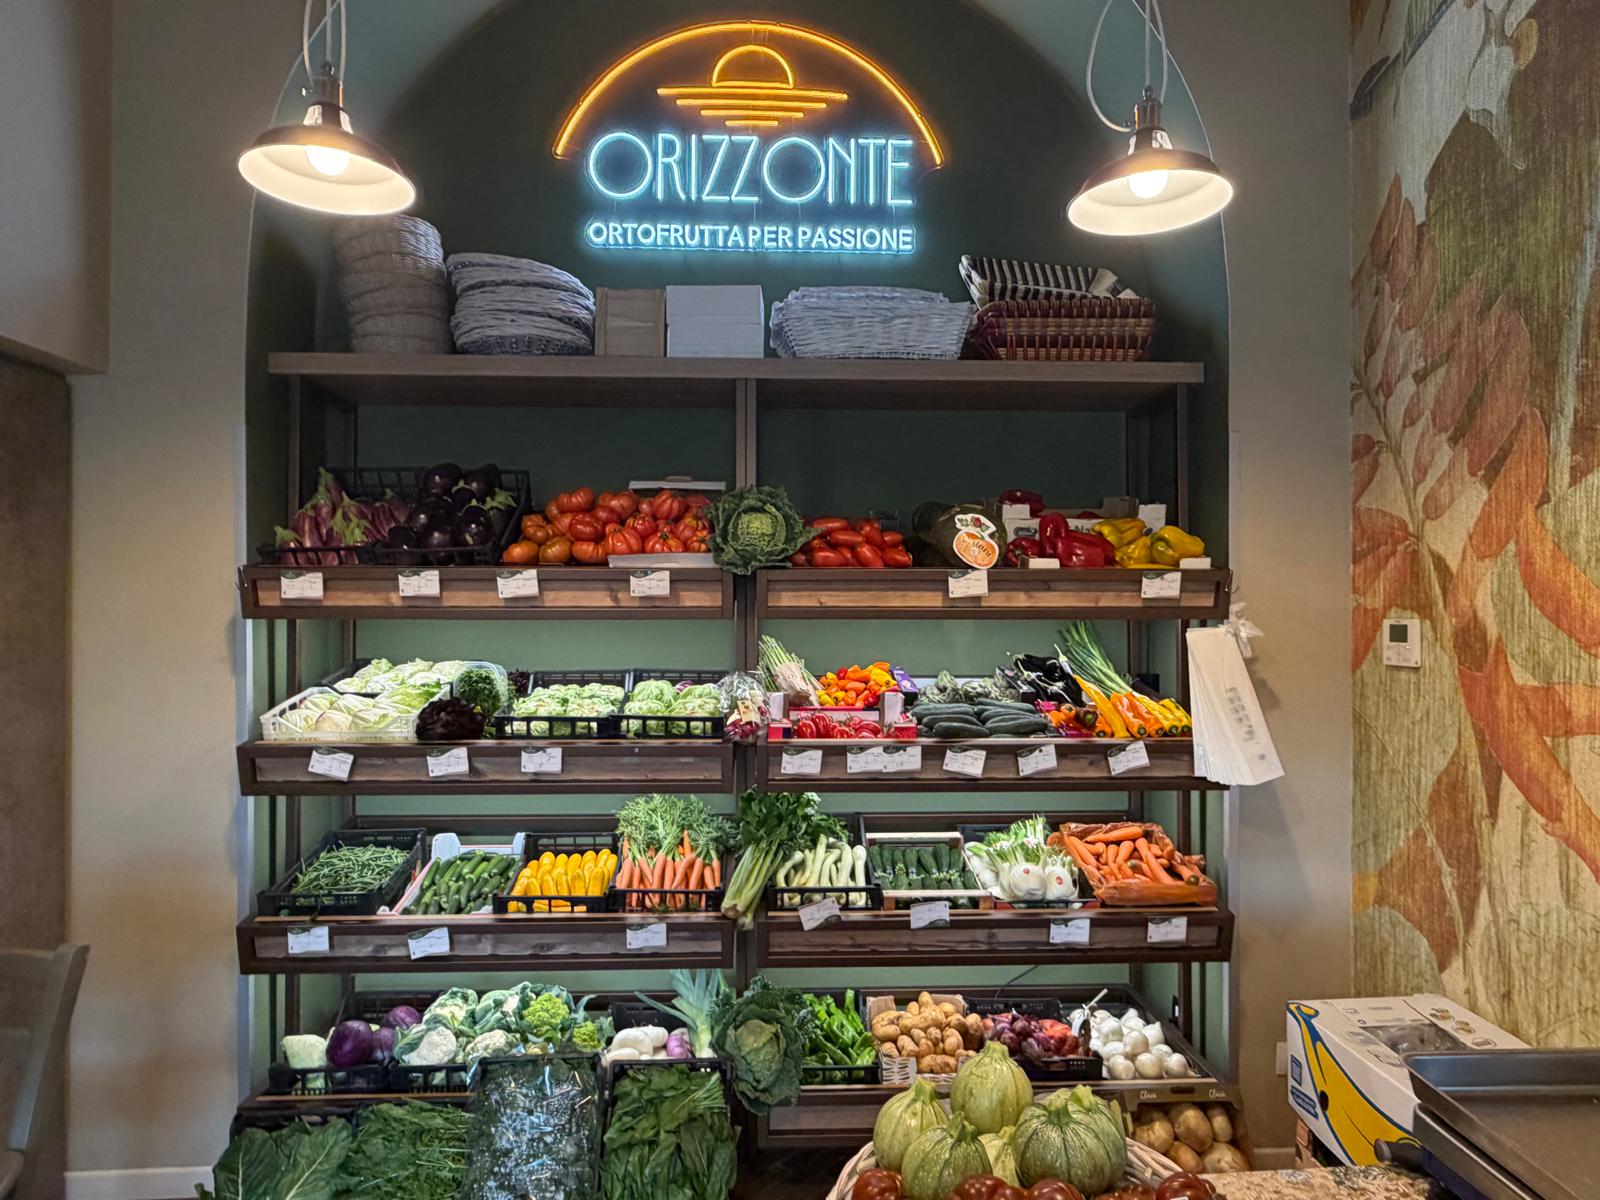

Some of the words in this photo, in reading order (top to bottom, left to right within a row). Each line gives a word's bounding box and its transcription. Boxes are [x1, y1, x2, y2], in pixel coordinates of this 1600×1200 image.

[588, 131, 914, 205] ORIZZONTE
[588, 222, 741, 247] ORTOFRUTTA
[748, 225, 793, 248] PER
[798, 226, 914, 250] PASSIONE
